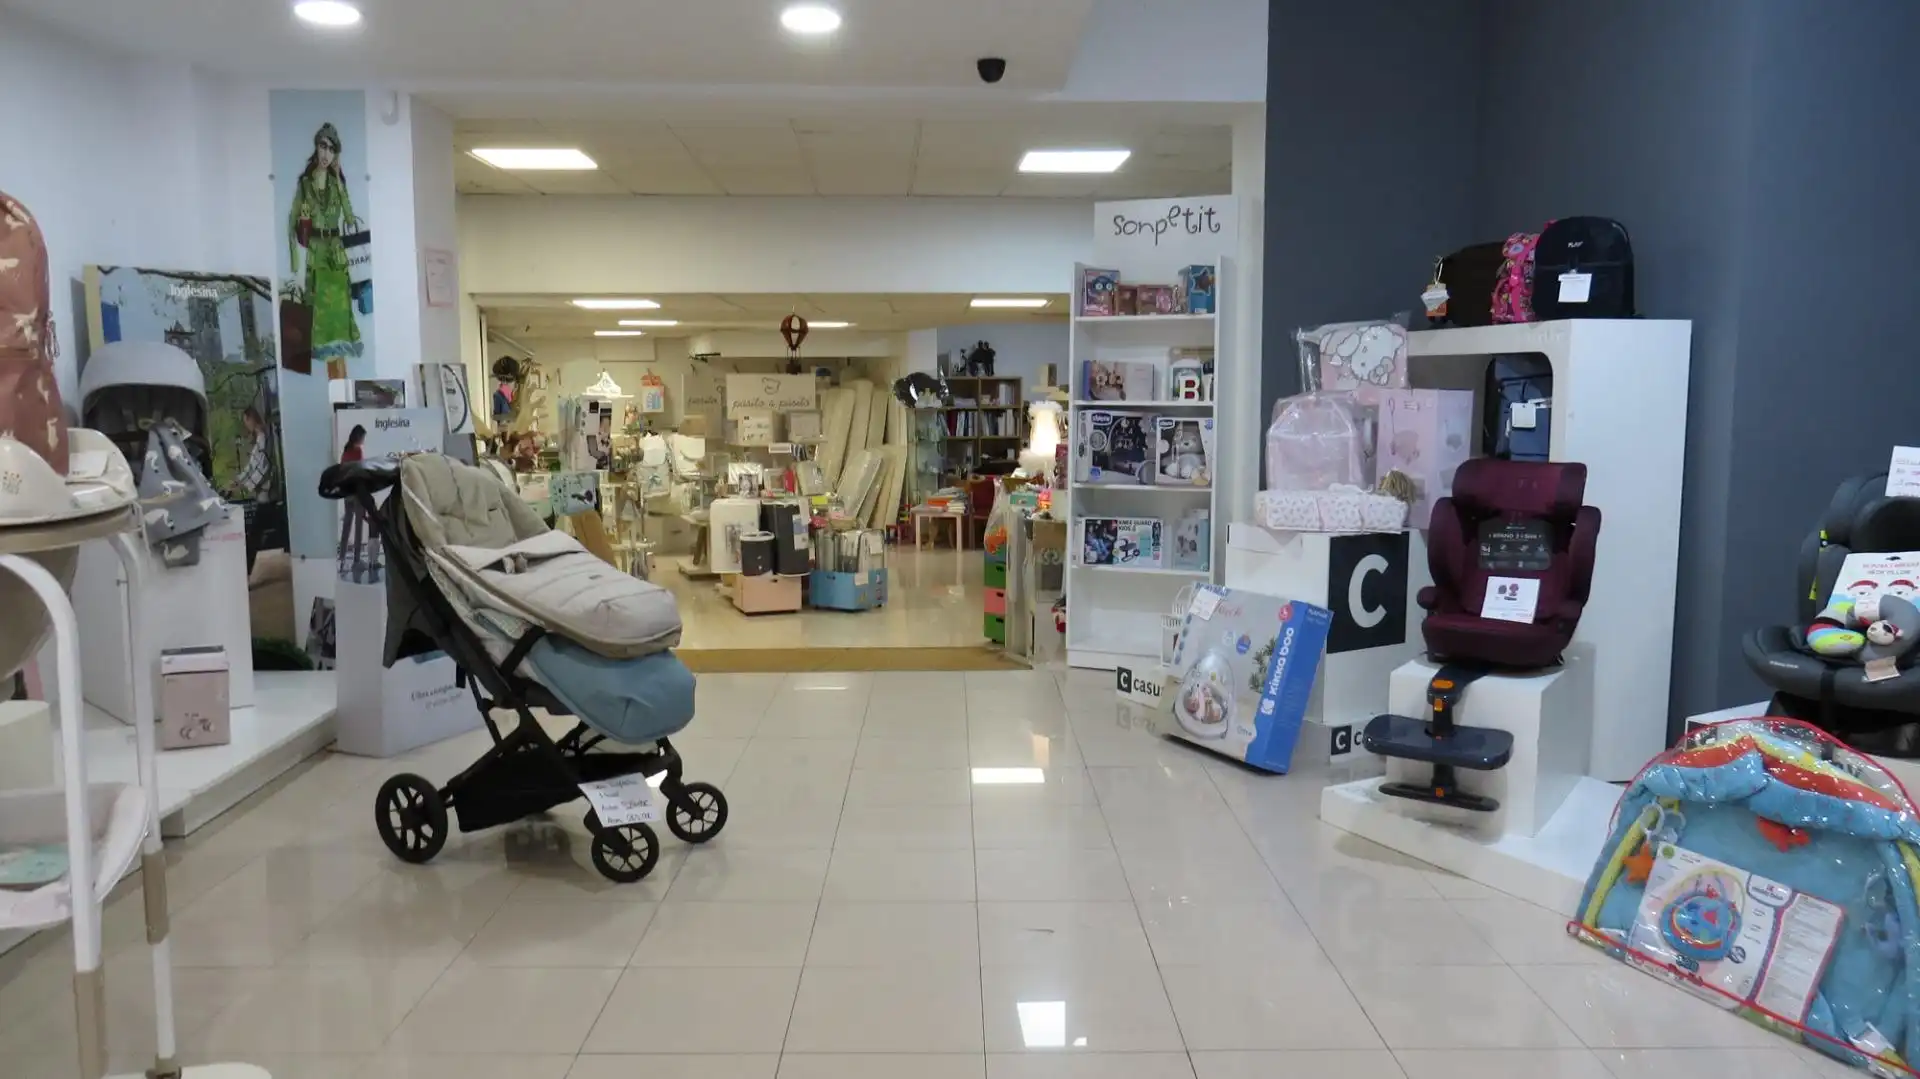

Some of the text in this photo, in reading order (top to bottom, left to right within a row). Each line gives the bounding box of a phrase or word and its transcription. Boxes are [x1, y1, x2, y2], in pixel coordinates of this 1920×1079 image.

[169, 283, 218, 300] Inglesina
[375, 416, 411, 431] Inglesina
[1348, 554, 1389, 628] C
[1133, 677, 1162, 697] casu
